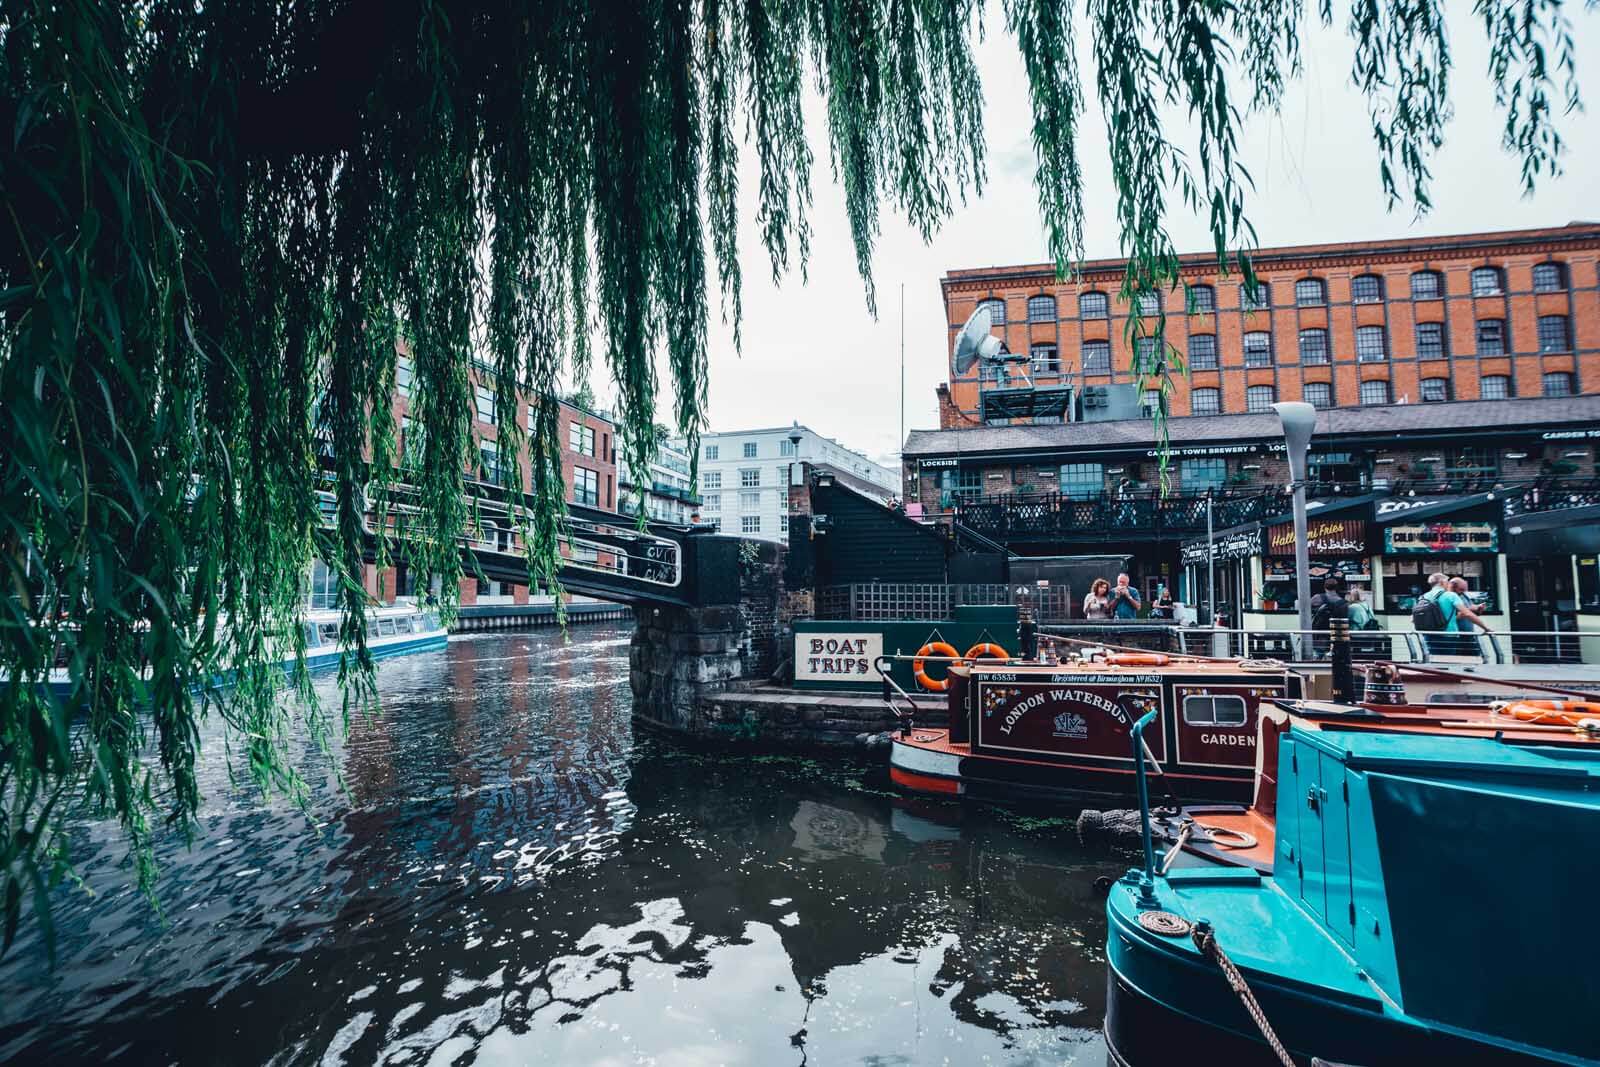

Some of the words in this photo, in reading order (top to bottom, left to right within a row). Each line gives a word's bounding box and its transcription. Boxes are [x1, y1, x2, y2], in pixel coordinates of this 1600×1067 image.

[1208, 446, 1249, 454] BREWERY
[1272, 527, 1318, 547] Hallmi
[1319, 522, 1344, 537] Fries
[810, 638, 868, 655] BOAT
[808, 657, 869, 674] TRIPS
[1000, 692, 1045, 735] LONDON
[1049, 689, 1127, 724] WATERBUS
[1200, 733, 1256, 746] GARDEN
